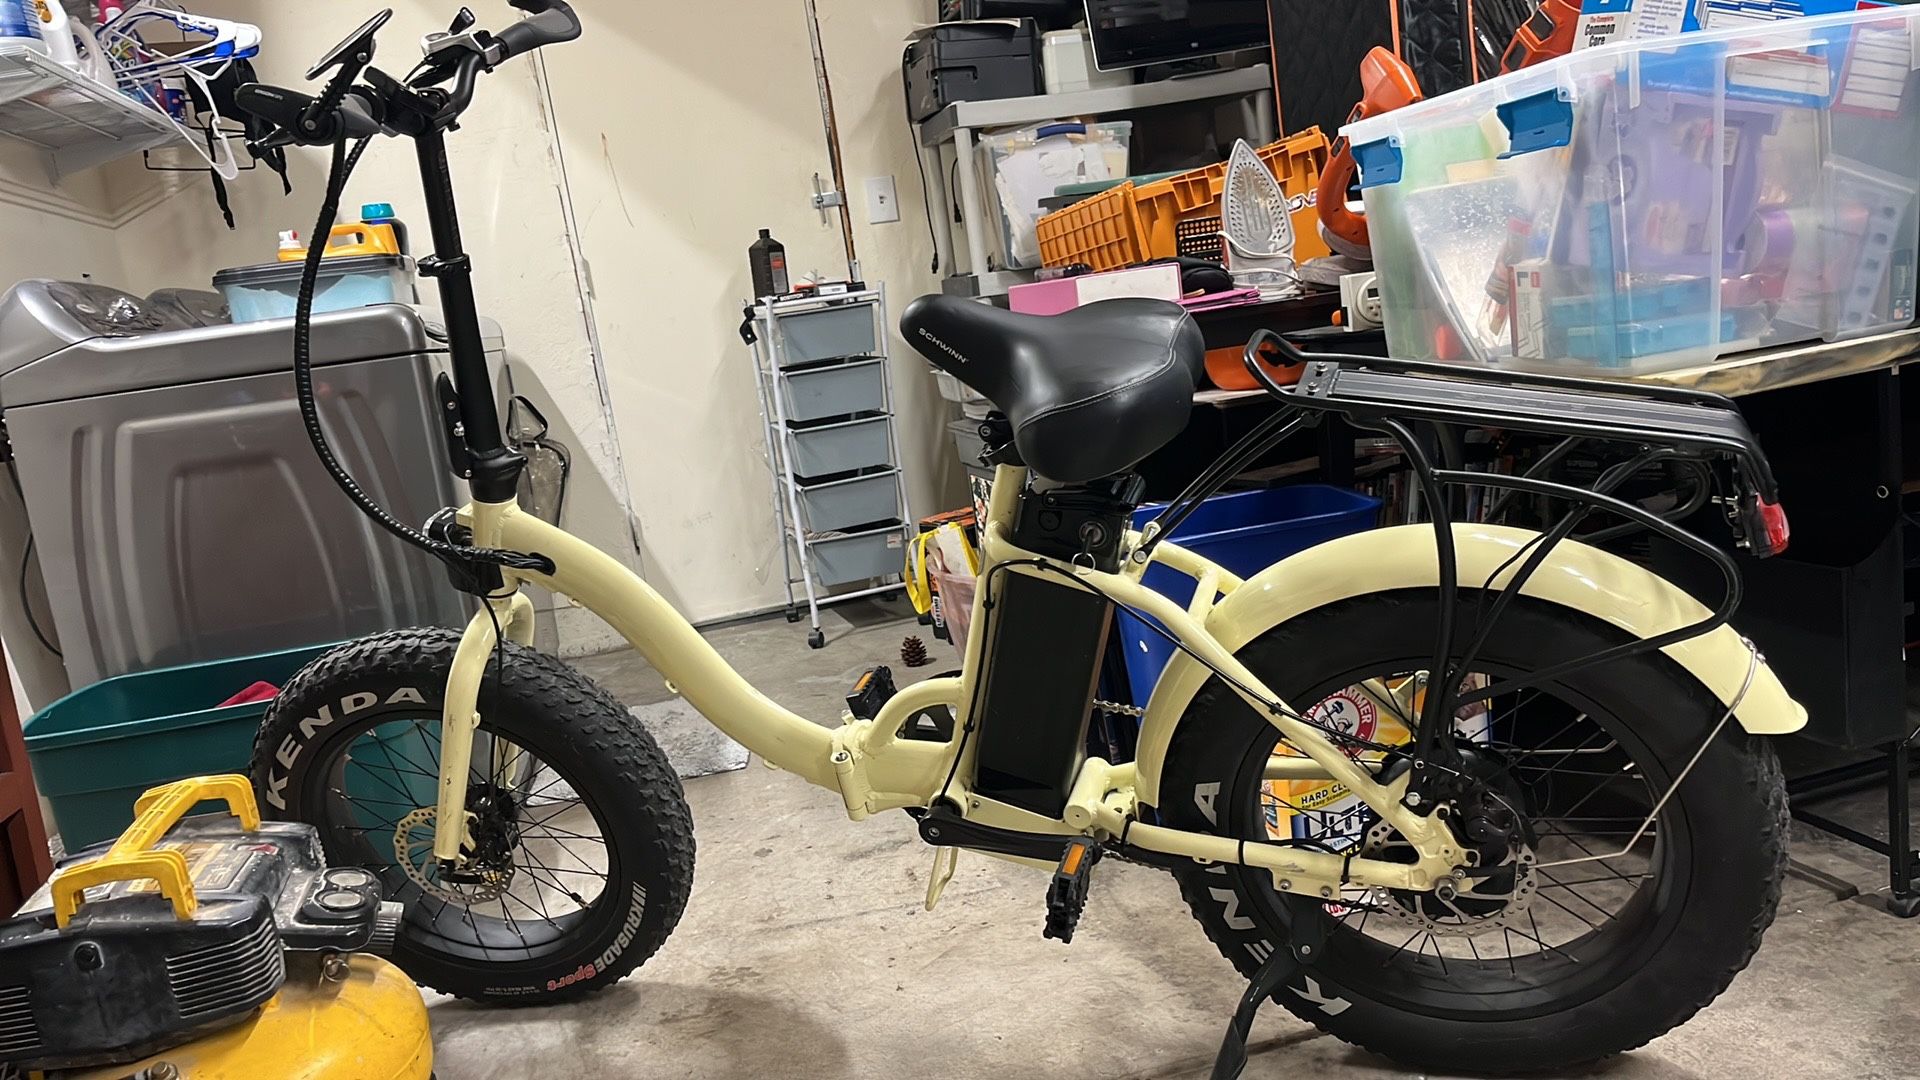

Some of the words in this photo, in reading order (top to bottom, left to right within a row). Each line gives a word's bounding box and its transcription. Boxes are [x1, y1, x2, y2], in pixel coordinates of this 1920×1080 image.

[1585, 24, 1615, 36] Common
[1589, 36, 1605, 47] Core
[918, 327, 966, 364] SCHWINN
[266, 687, 427, 811] KENDA
[1301, 789, 1329, 805] HARD
[1194, 782, 1353, 1016] KENA
[595, 900, 646, 974] KRUSADE
[546, 963, 597, 992] Sport
